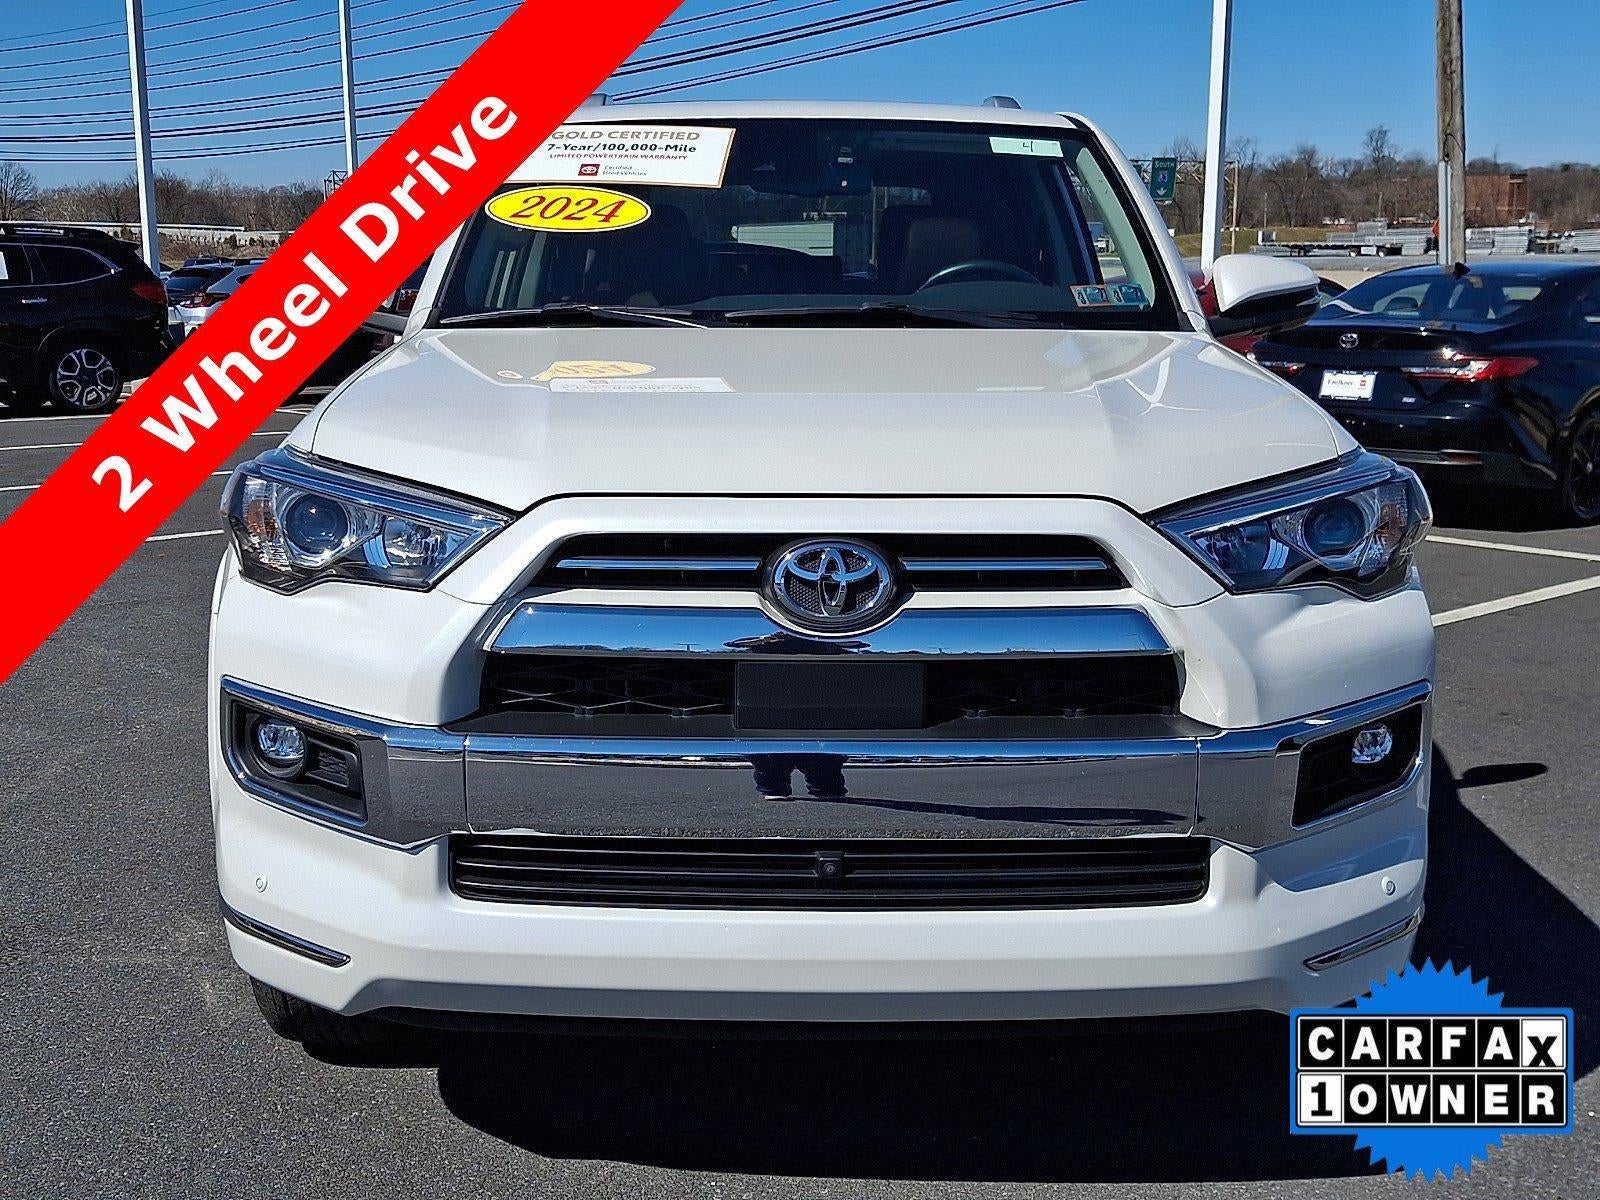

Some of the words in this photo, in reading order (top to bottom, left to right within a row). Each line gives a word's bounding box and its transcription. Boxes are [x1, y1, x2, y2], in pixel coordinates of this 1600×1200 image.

[551, 131, 603, 140] GOLD
[607, 131, 700, 141] CERTIFIED
[547, 143, 697, 153] 7-Year/100,000-Mile
[509, 195, 627, 223] 2024
